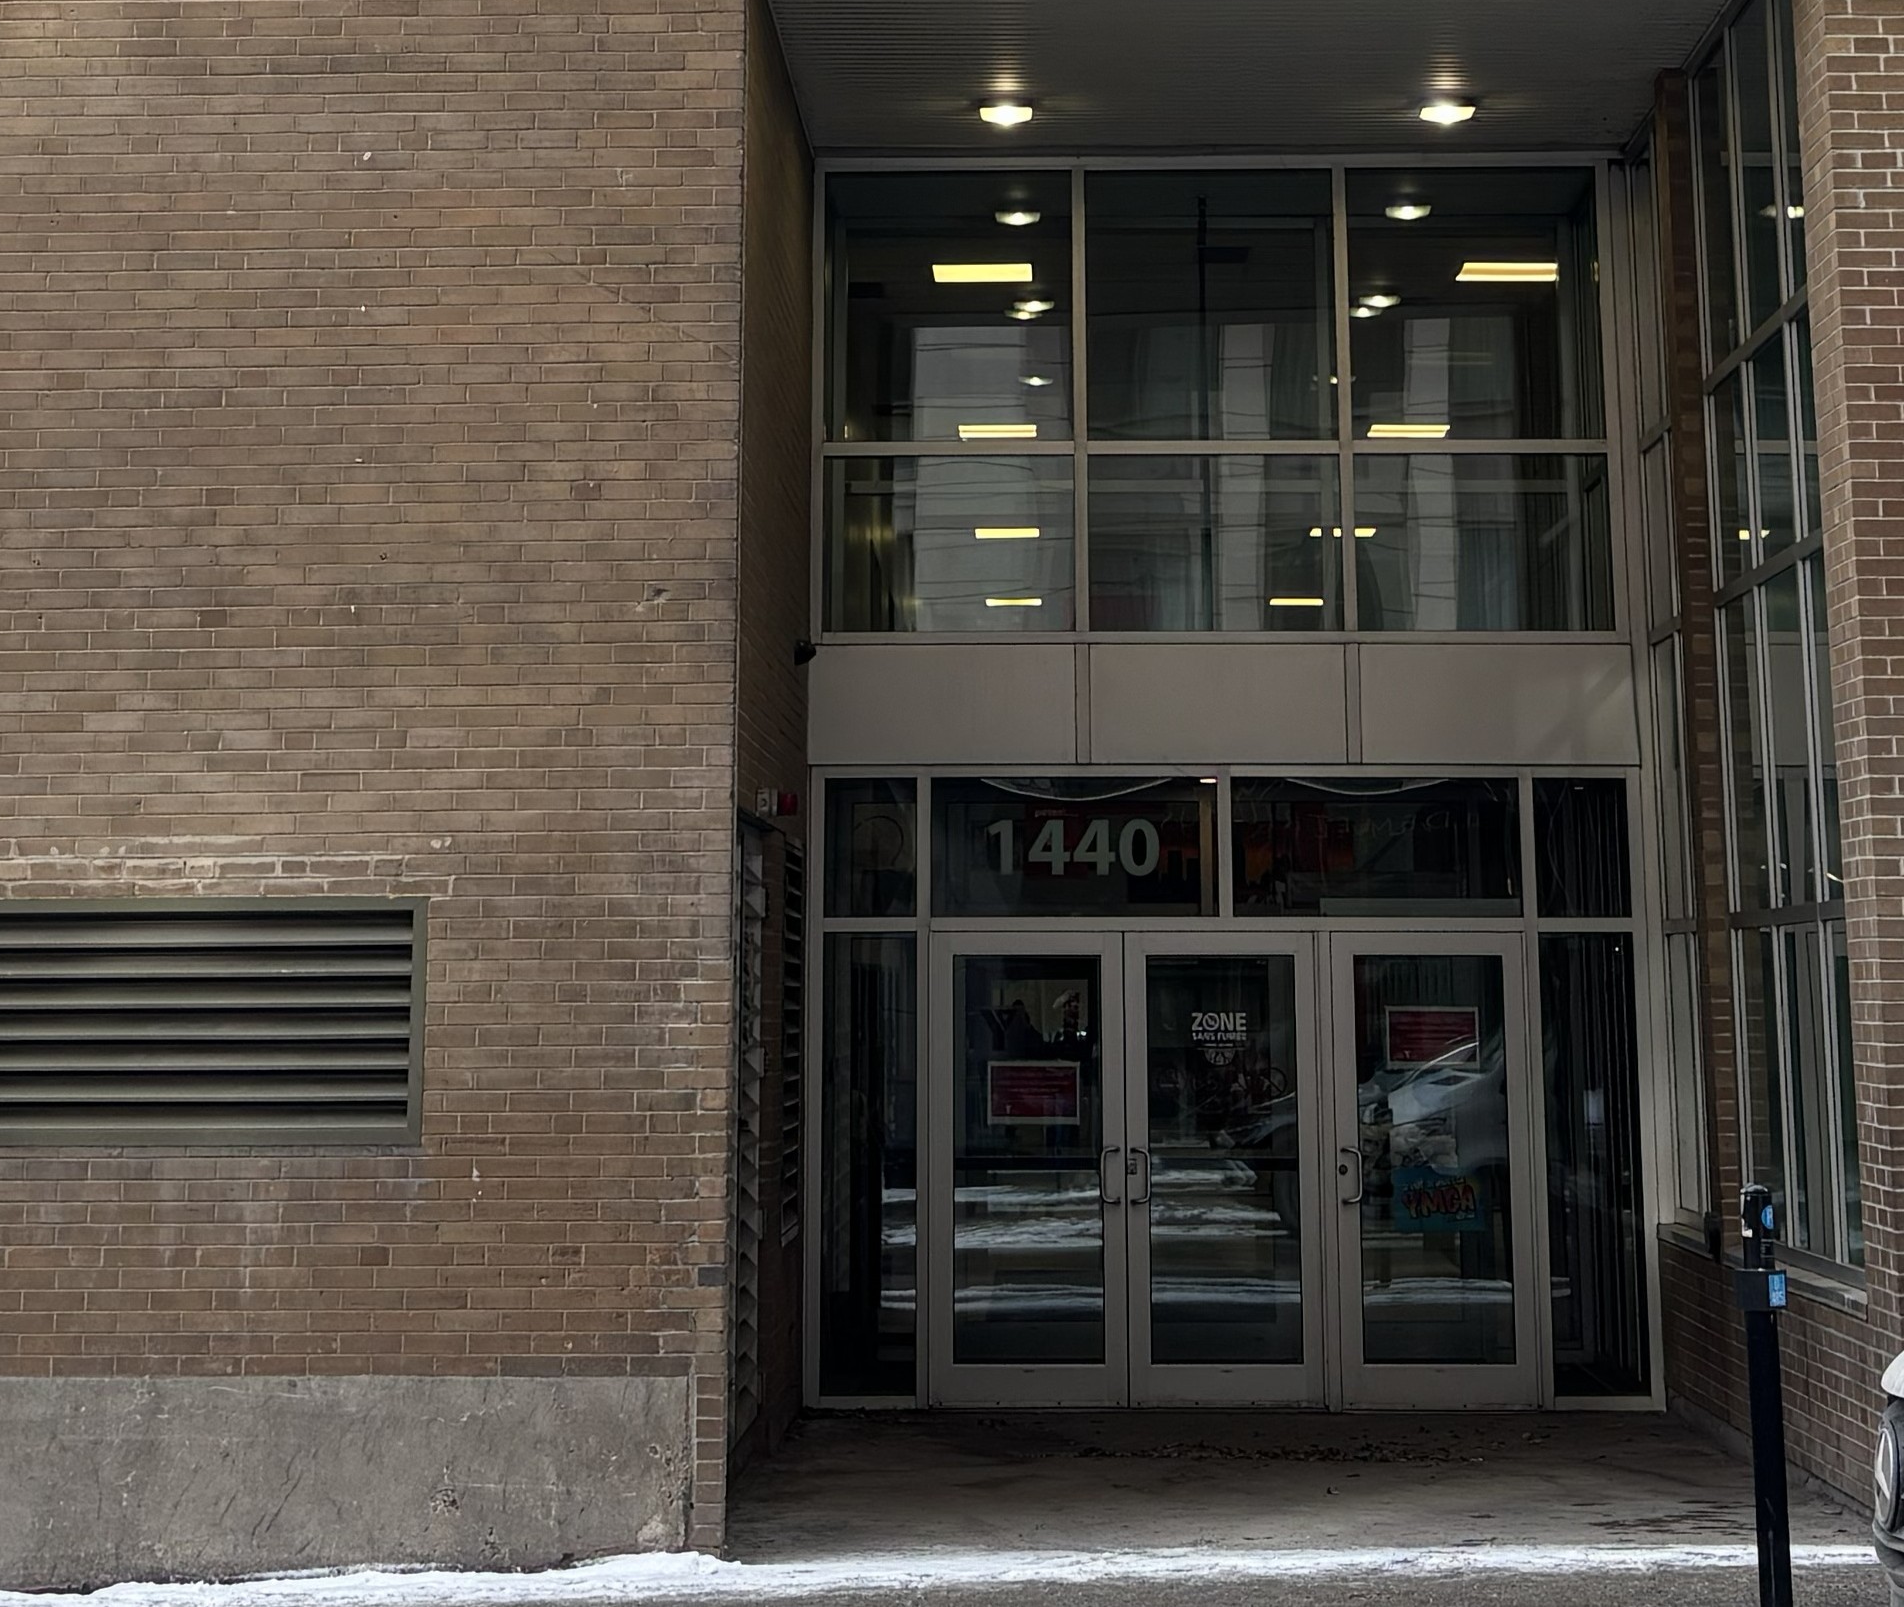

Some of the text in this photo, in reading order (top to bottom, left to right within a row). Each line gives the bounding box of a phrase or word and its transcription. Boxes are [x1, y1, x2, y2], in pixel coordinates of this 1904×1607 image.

[985, 817, 1160, 877] 1440
[1191, 1011, 1247, 1031] ZONE
[1401, 1184, 1476, 1220] YMCA
